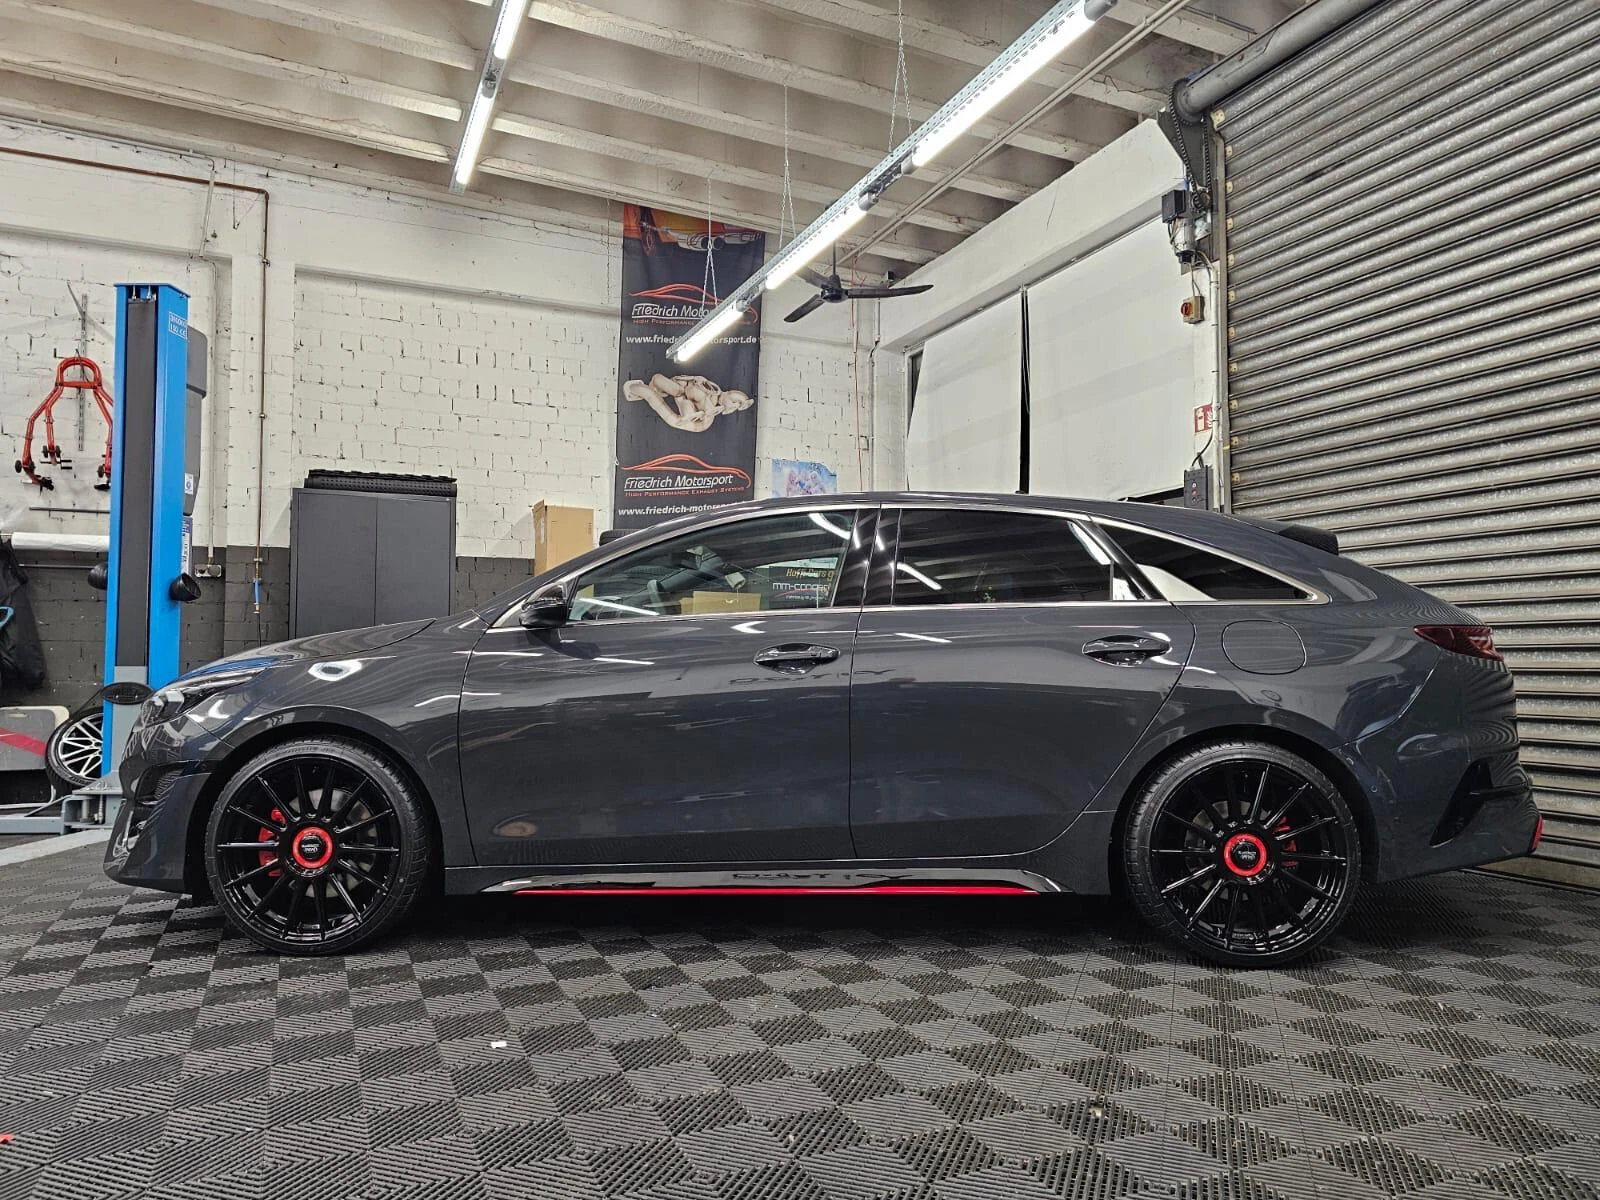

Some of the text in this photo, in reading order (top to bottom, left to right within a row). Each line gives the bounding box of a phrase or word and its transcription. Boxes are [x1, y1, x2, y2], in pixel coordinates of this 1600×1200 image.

[632, 303, 678, 317] Friedrich
[624, 474, 733, 489] Friedrich Motorsport
